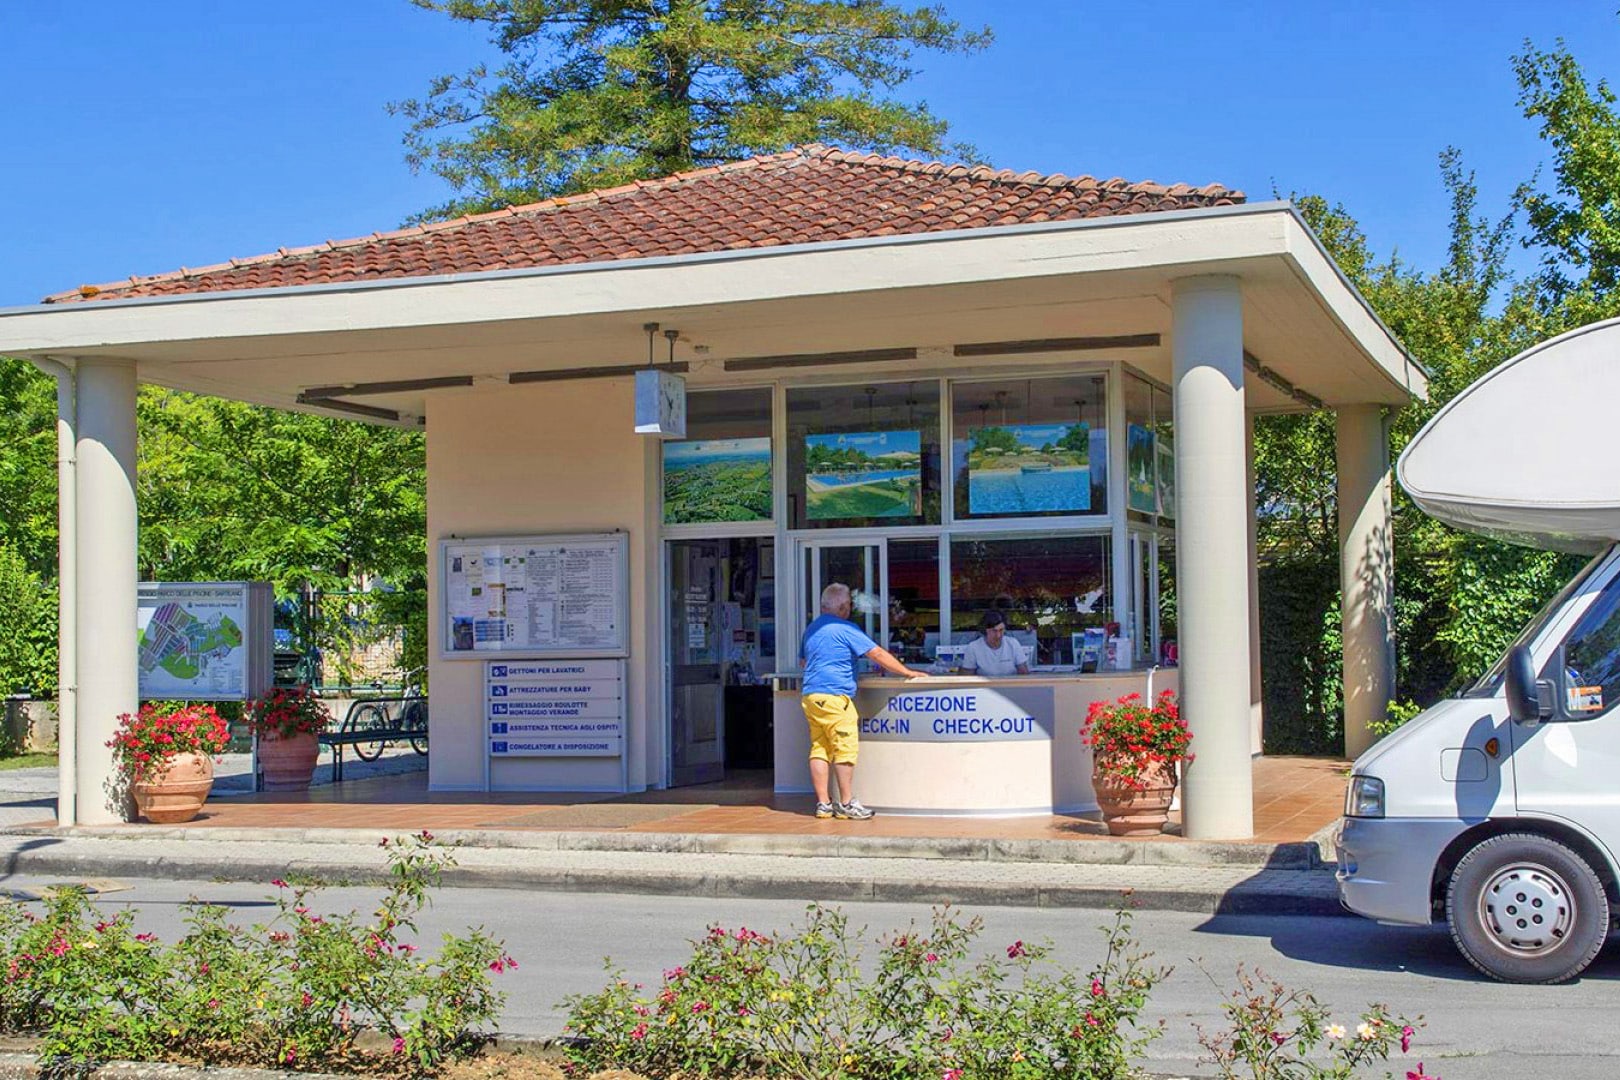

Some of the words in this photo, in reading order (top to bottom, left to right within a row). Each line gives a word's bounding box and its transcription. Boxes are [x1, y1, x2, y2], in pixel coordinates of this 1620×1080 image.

[888, 697, 976, 712] RICEZIONE
[858, 719, 910, 733] ECK-IN
[933, 717, 1035, 734] CHECK-OUT
